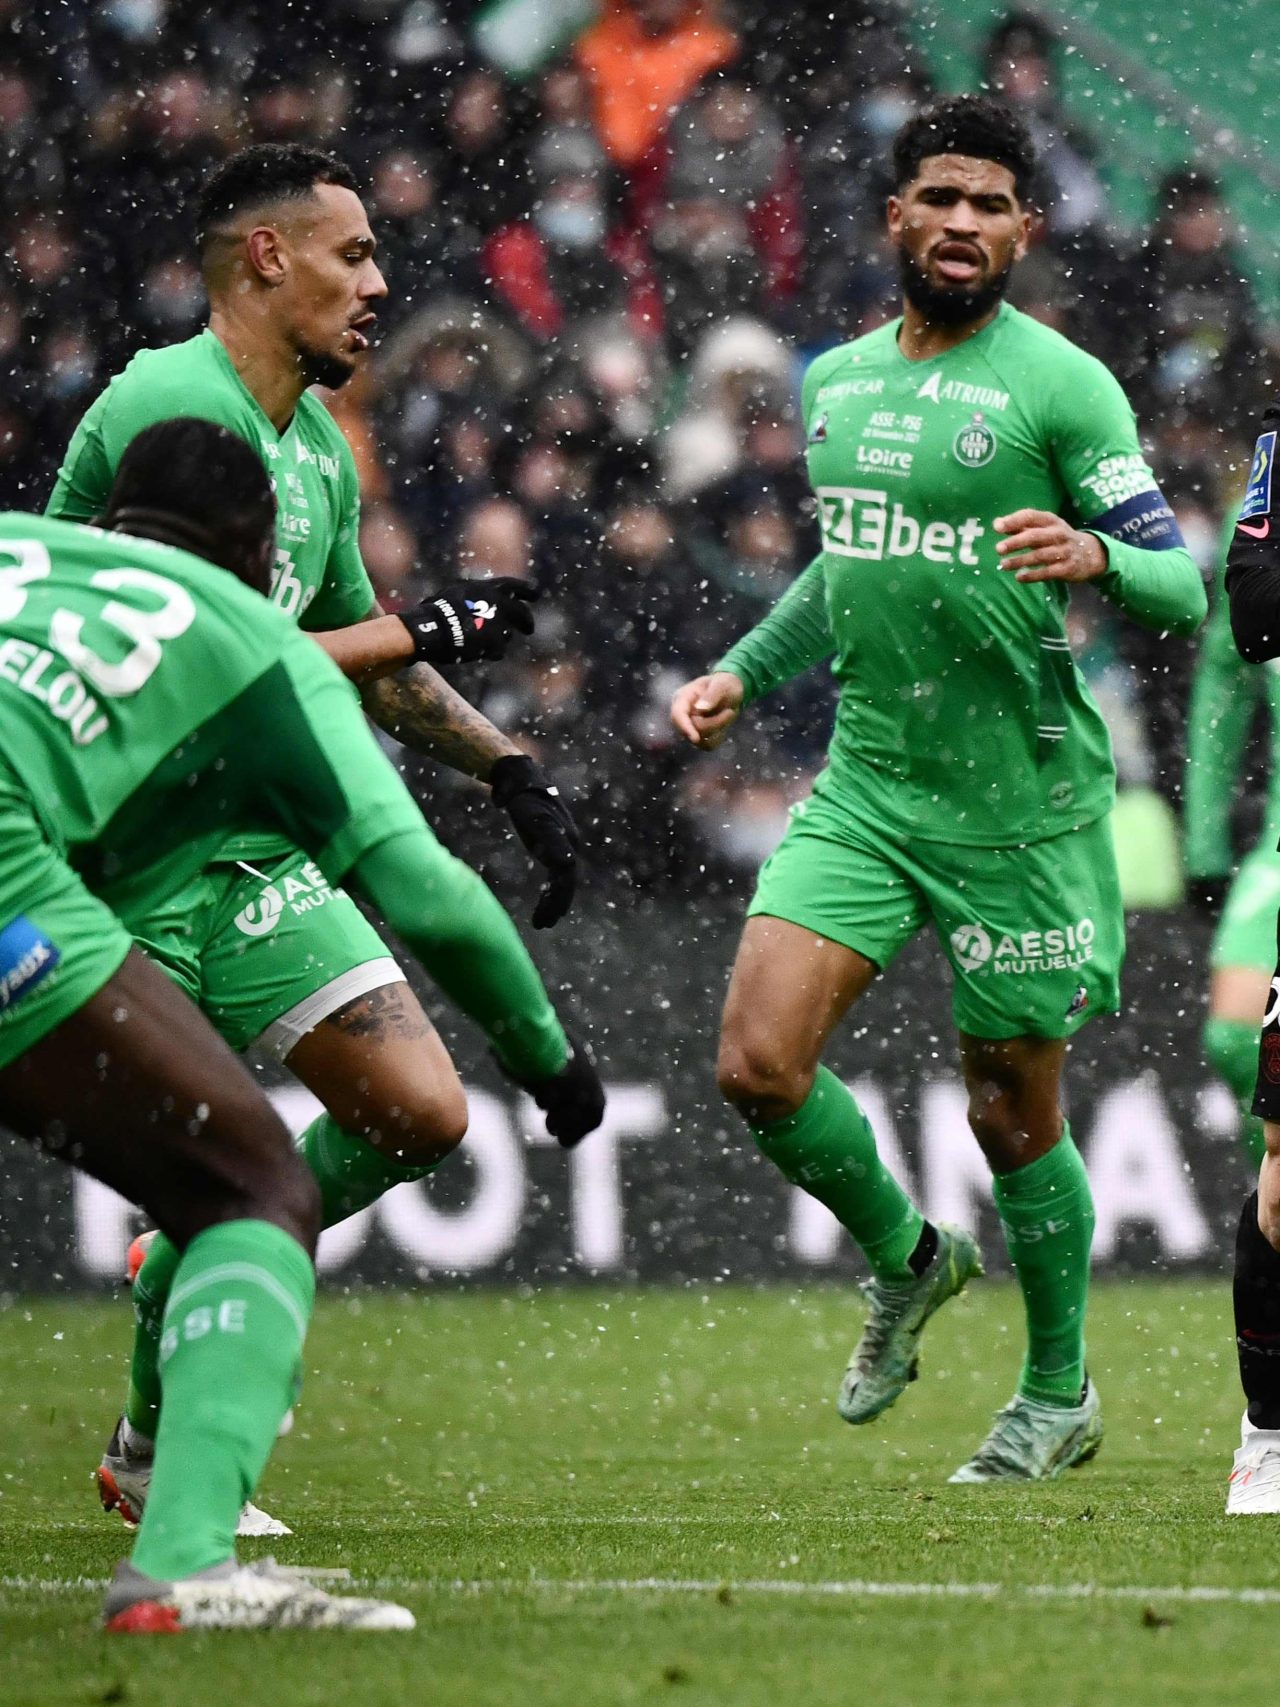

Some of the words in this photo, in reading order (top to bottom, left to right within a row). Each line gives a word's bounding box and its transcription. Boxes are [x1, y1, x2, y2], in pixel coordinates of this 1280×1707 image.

[941, 379, 1011, 412] ATRIUM
[857, 444, 914, 469] Loire
[1097, 454, 1150, 479] SMA
[820, 486, 985, 565] ZEbet
[418, 621, 439, 633] 5
[0, 637, 110, 746] ELOU
[994, 945, 1094, 975] MUTUELLE
